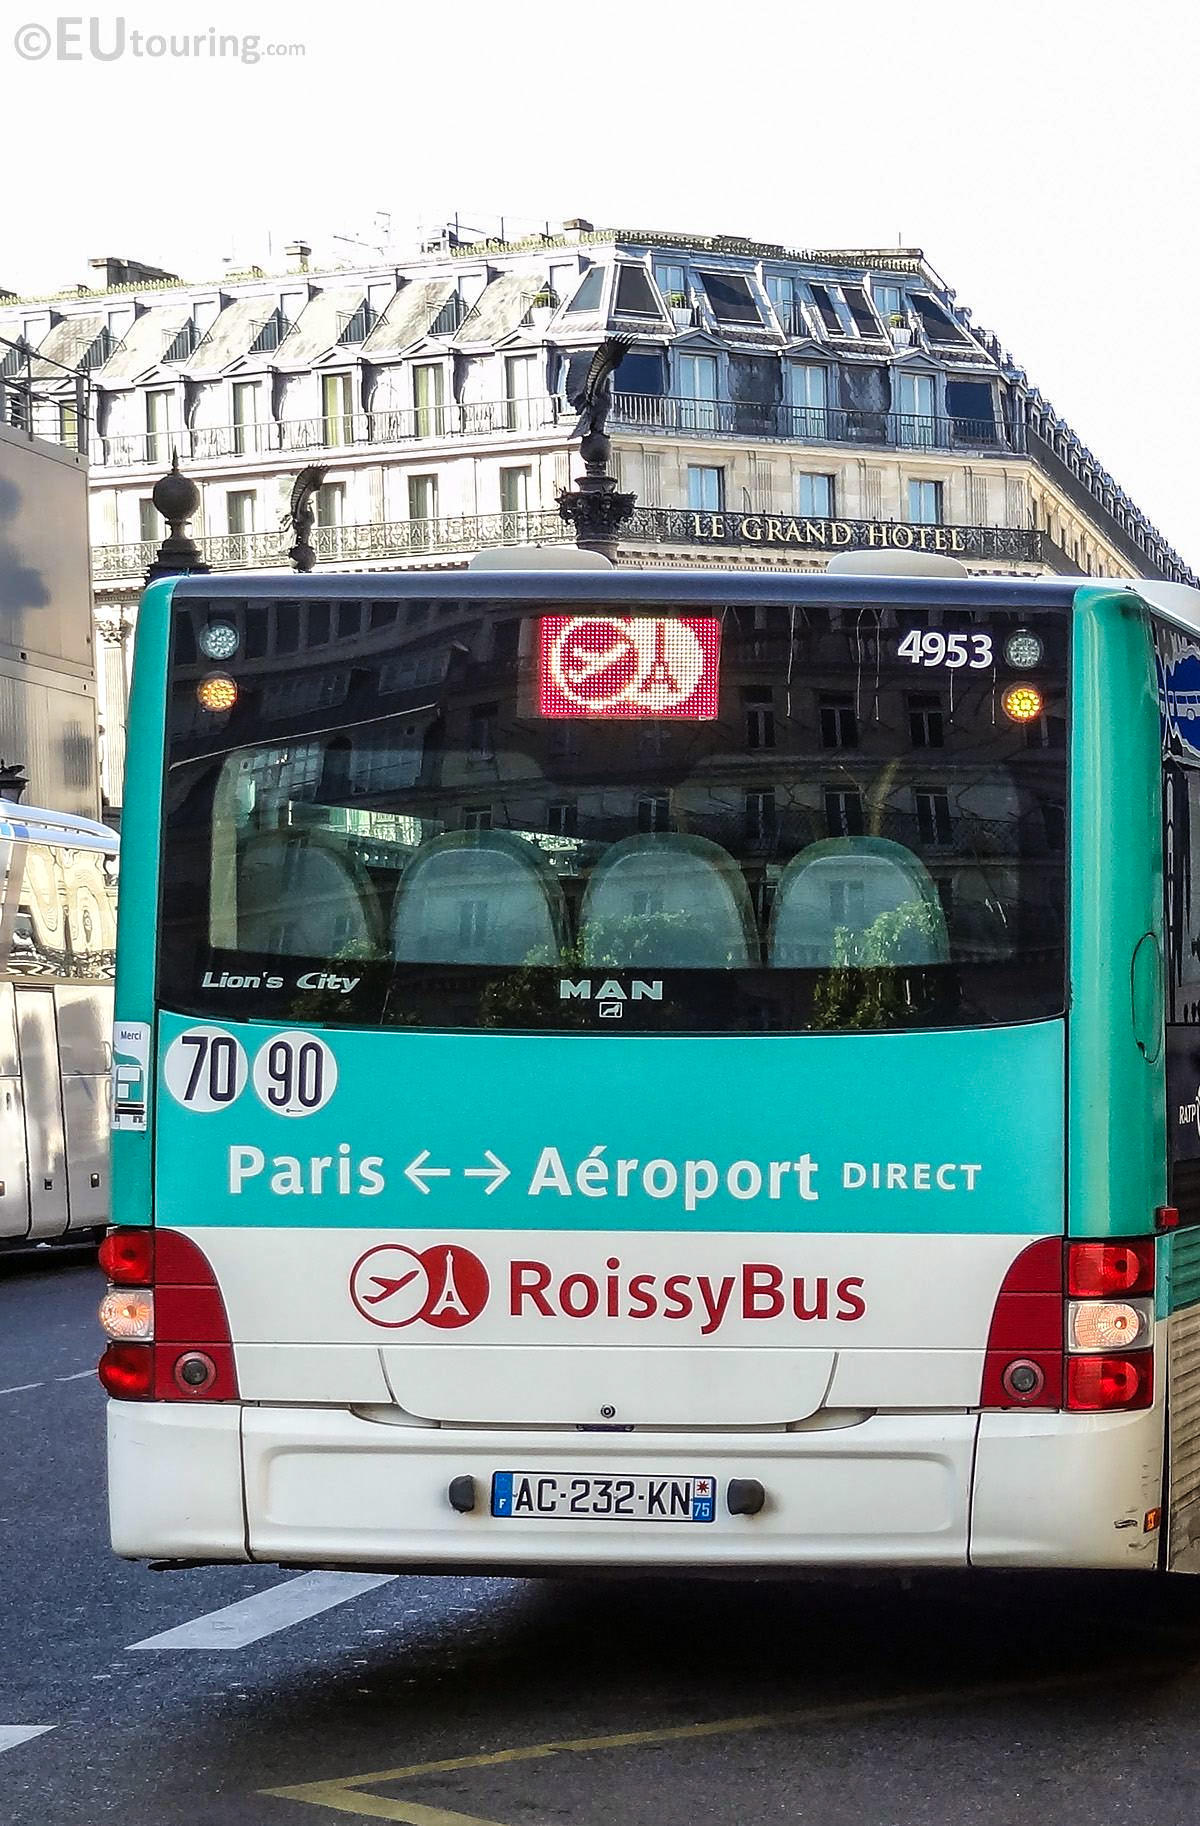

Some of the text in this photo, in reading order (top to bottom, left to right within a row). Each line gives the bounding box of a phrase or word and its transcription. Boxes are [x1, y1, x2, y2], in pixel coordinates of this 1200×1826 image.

[693, 514, 965, 551] LE GRAND HOTEL
[898, 630, 993, 669] 4953
[201, 971, 361, 994] Lion's City
[560, 979, 663, 1000] MAN
[120, 1030, 142, 1041] Merci
[182, 1035, 237, 1102] 70
[268, 1040, 324, 1107] 90
[1179, 1103, 1197, 1125] RATP
[228, 1142, 982, 1212] Paris Aéroport DIRECT
[510, 1256, 867, 1336] RoissyBus
[499, 1477, 710, 1518] F AC-232-KN 75
